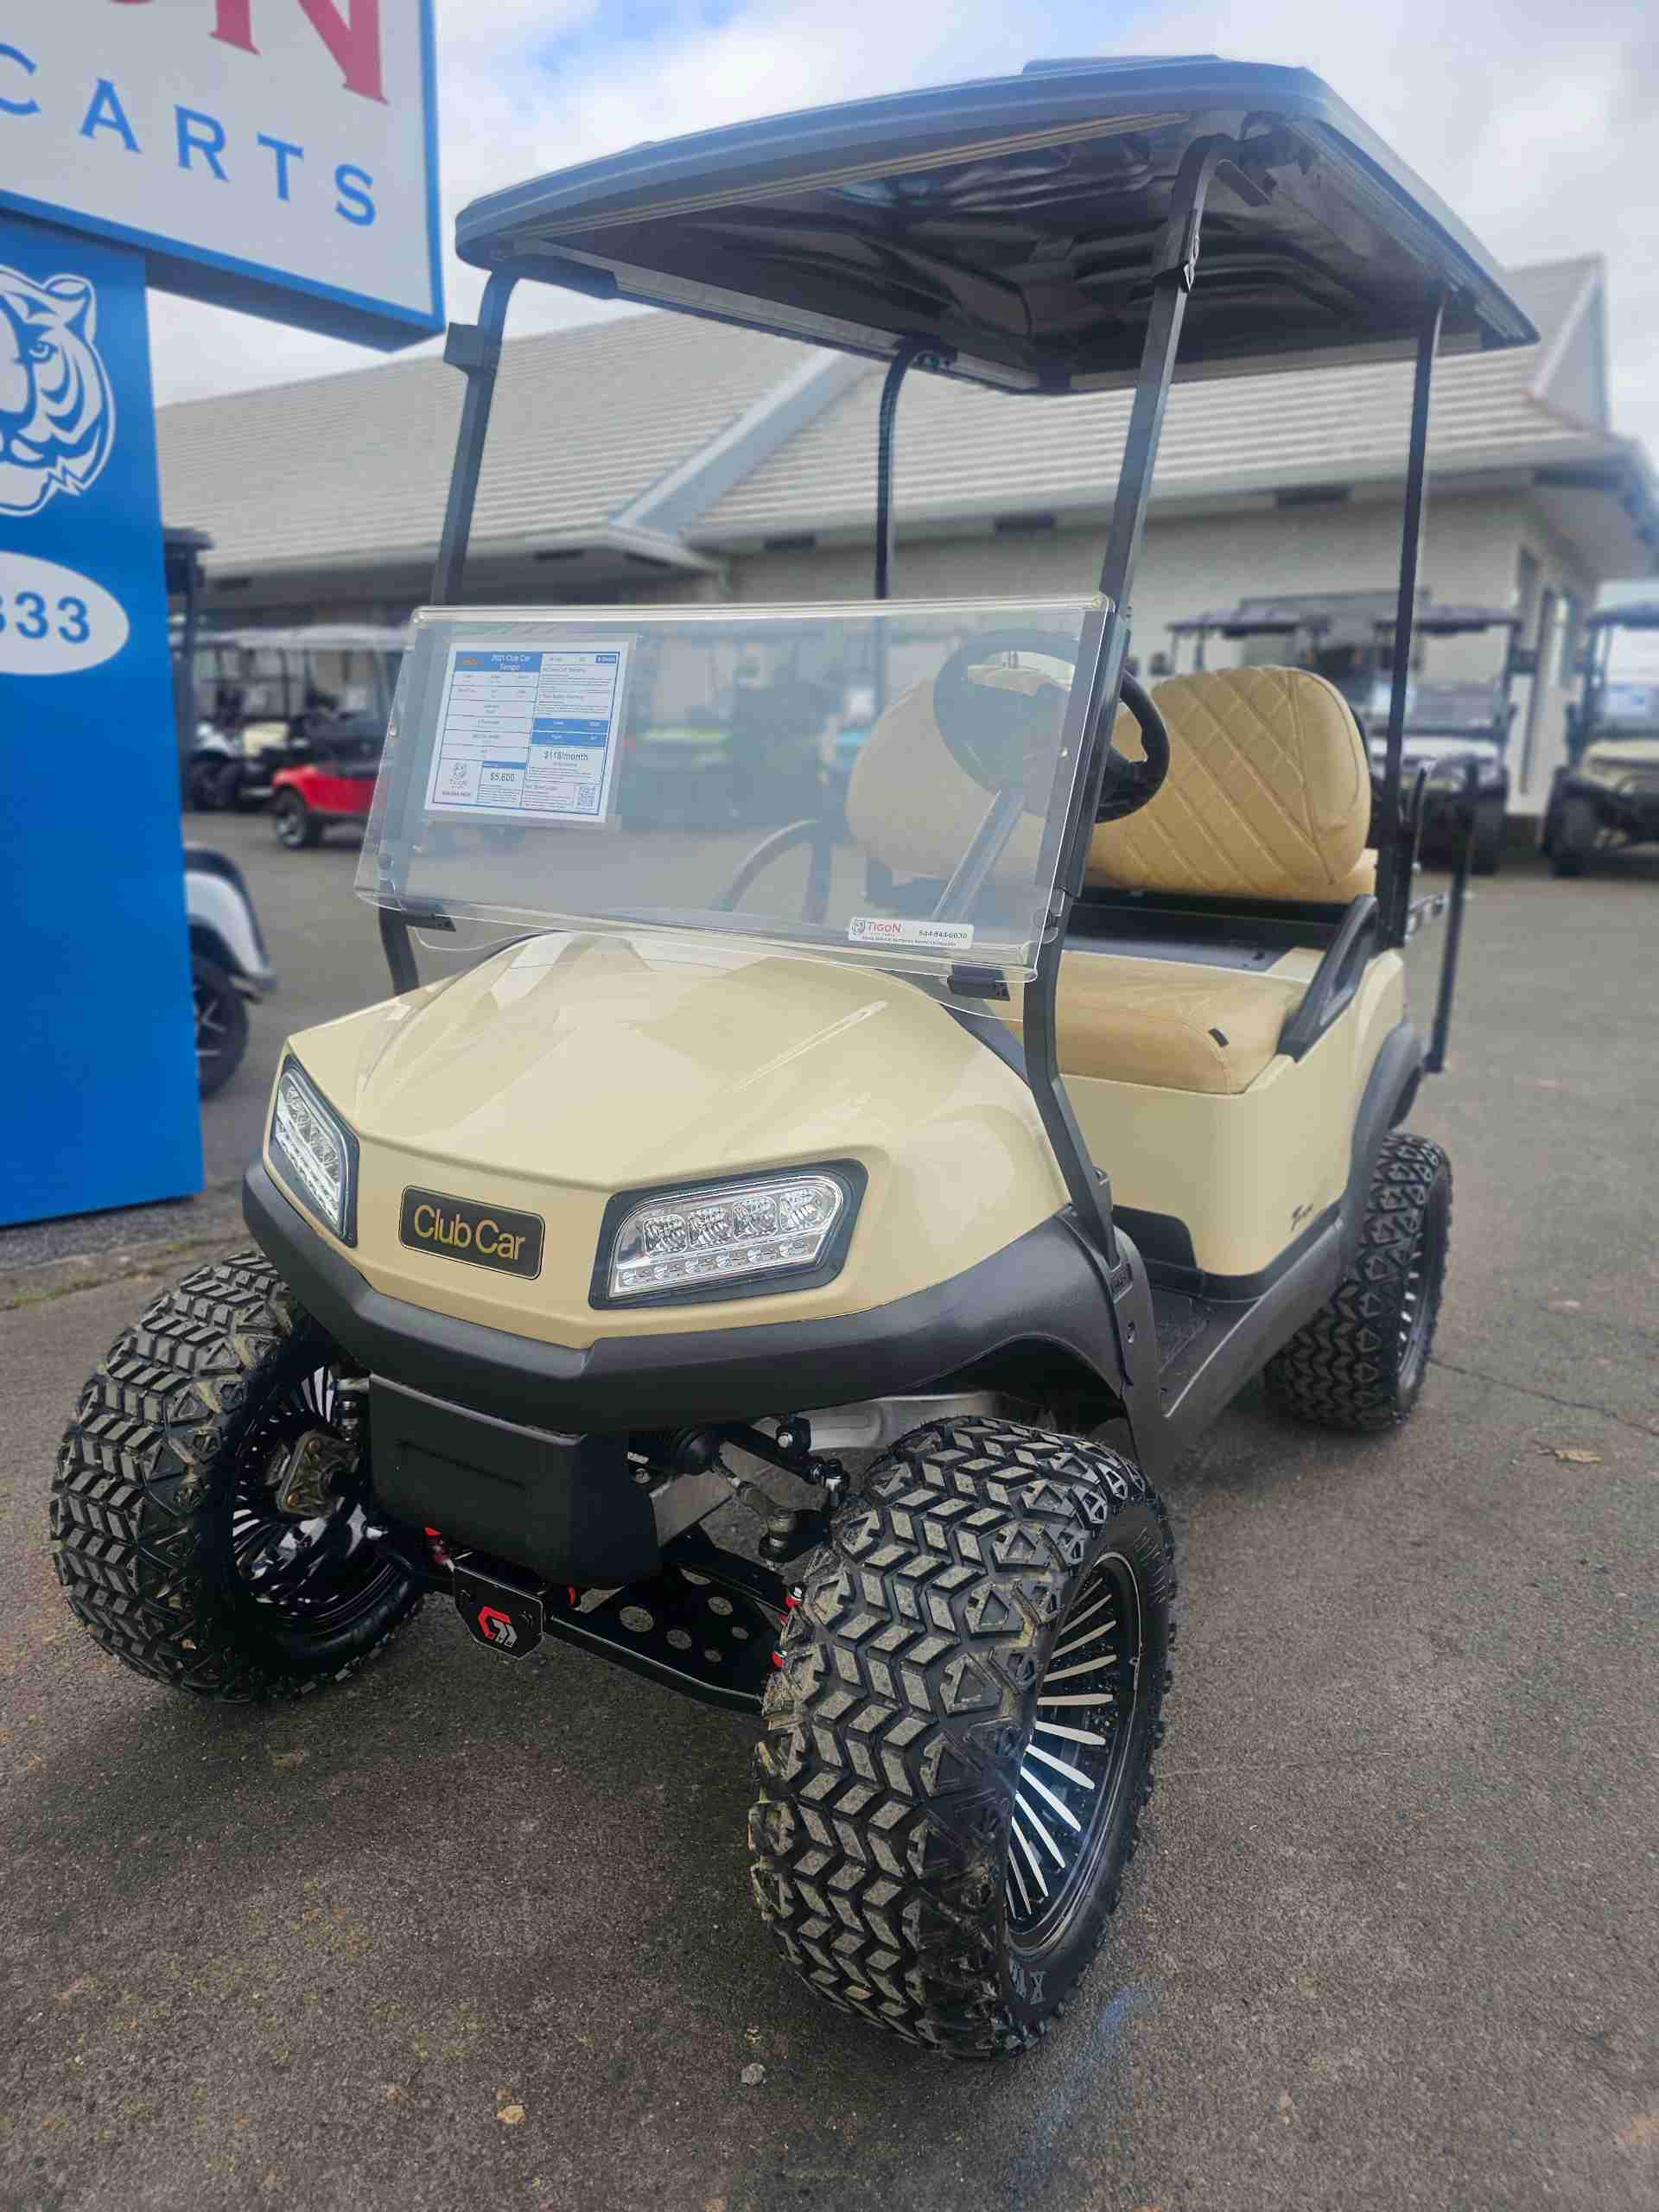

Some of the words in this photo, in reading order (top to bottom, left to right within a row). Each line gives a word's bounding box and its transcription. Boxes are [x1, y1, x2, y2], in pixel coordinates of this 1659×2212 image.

[0, 591, 91, 645] 33
[414, 1204, 472, 1249] Club
[475, 1219, 526, 1260] Car
